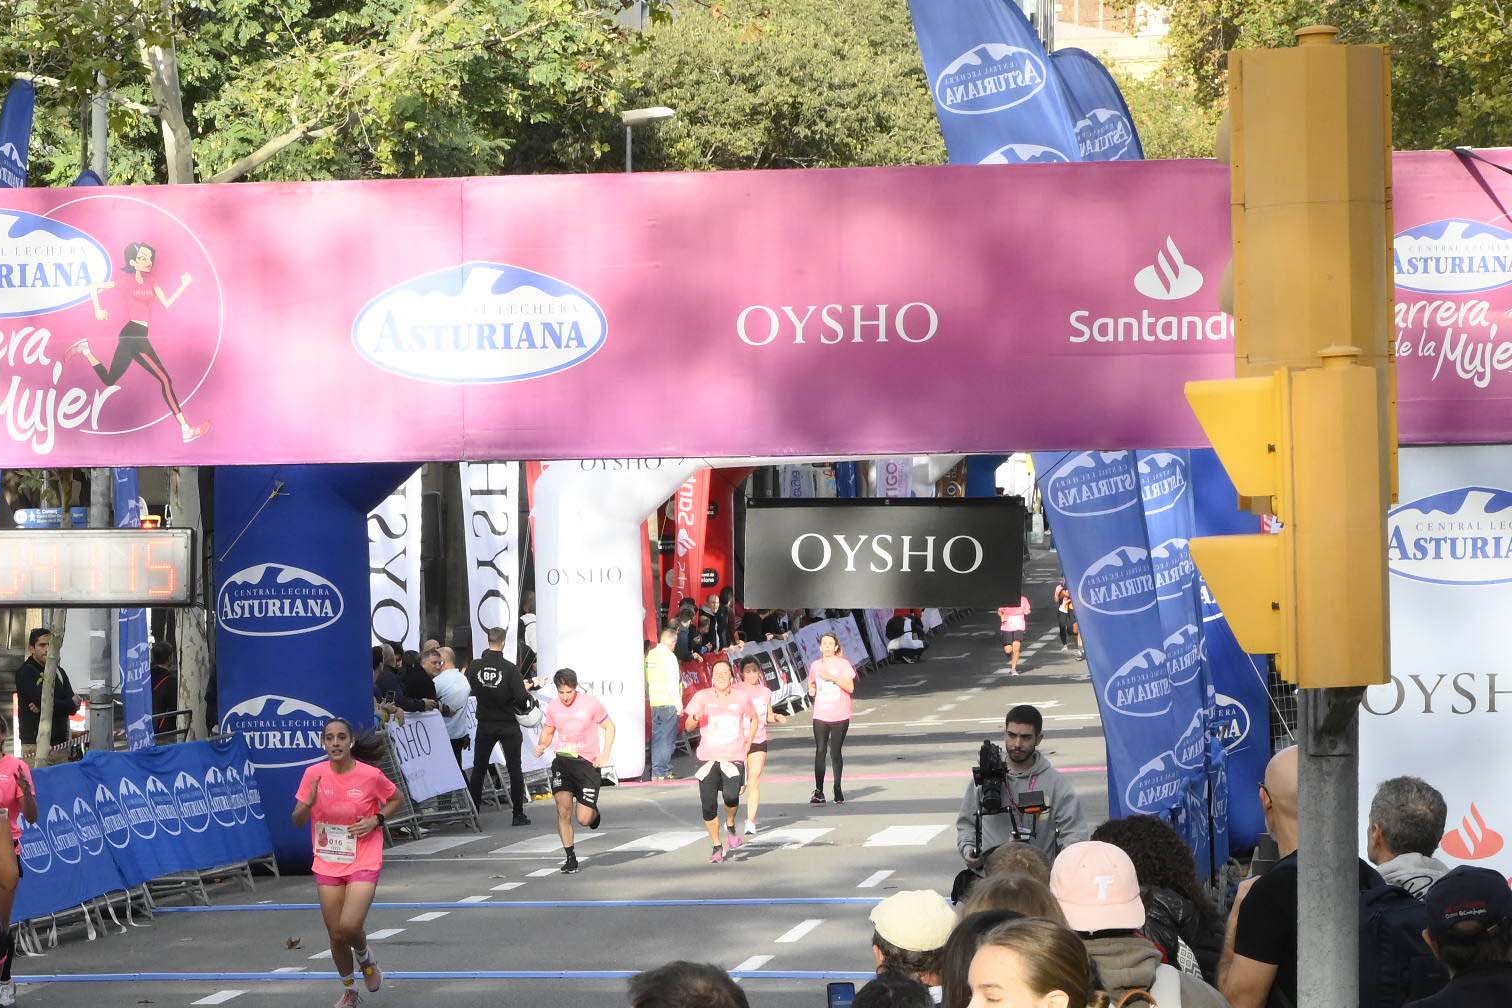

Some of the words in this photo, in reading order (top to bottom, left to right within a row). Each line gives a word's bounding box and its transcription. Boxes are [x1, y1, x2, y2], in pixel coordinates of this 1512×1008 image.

[736, 302, 939, 346] OYSHO
[1394, 299, 1490, 329] arrera
[1418, 329, 1437, 357] la
[1416, 521, 1482, 532] CENTRAL
[790, 533, 984, 574] OYSHO
[234, 588, 277, 597] CENTRAL
[281, 588, 330, 596] LECHERA
[222, 593, 335, 620] ASTURIANA
[236, 719, 277, 728] CENTRAL
[281, 719, 325, 728] LECHER
